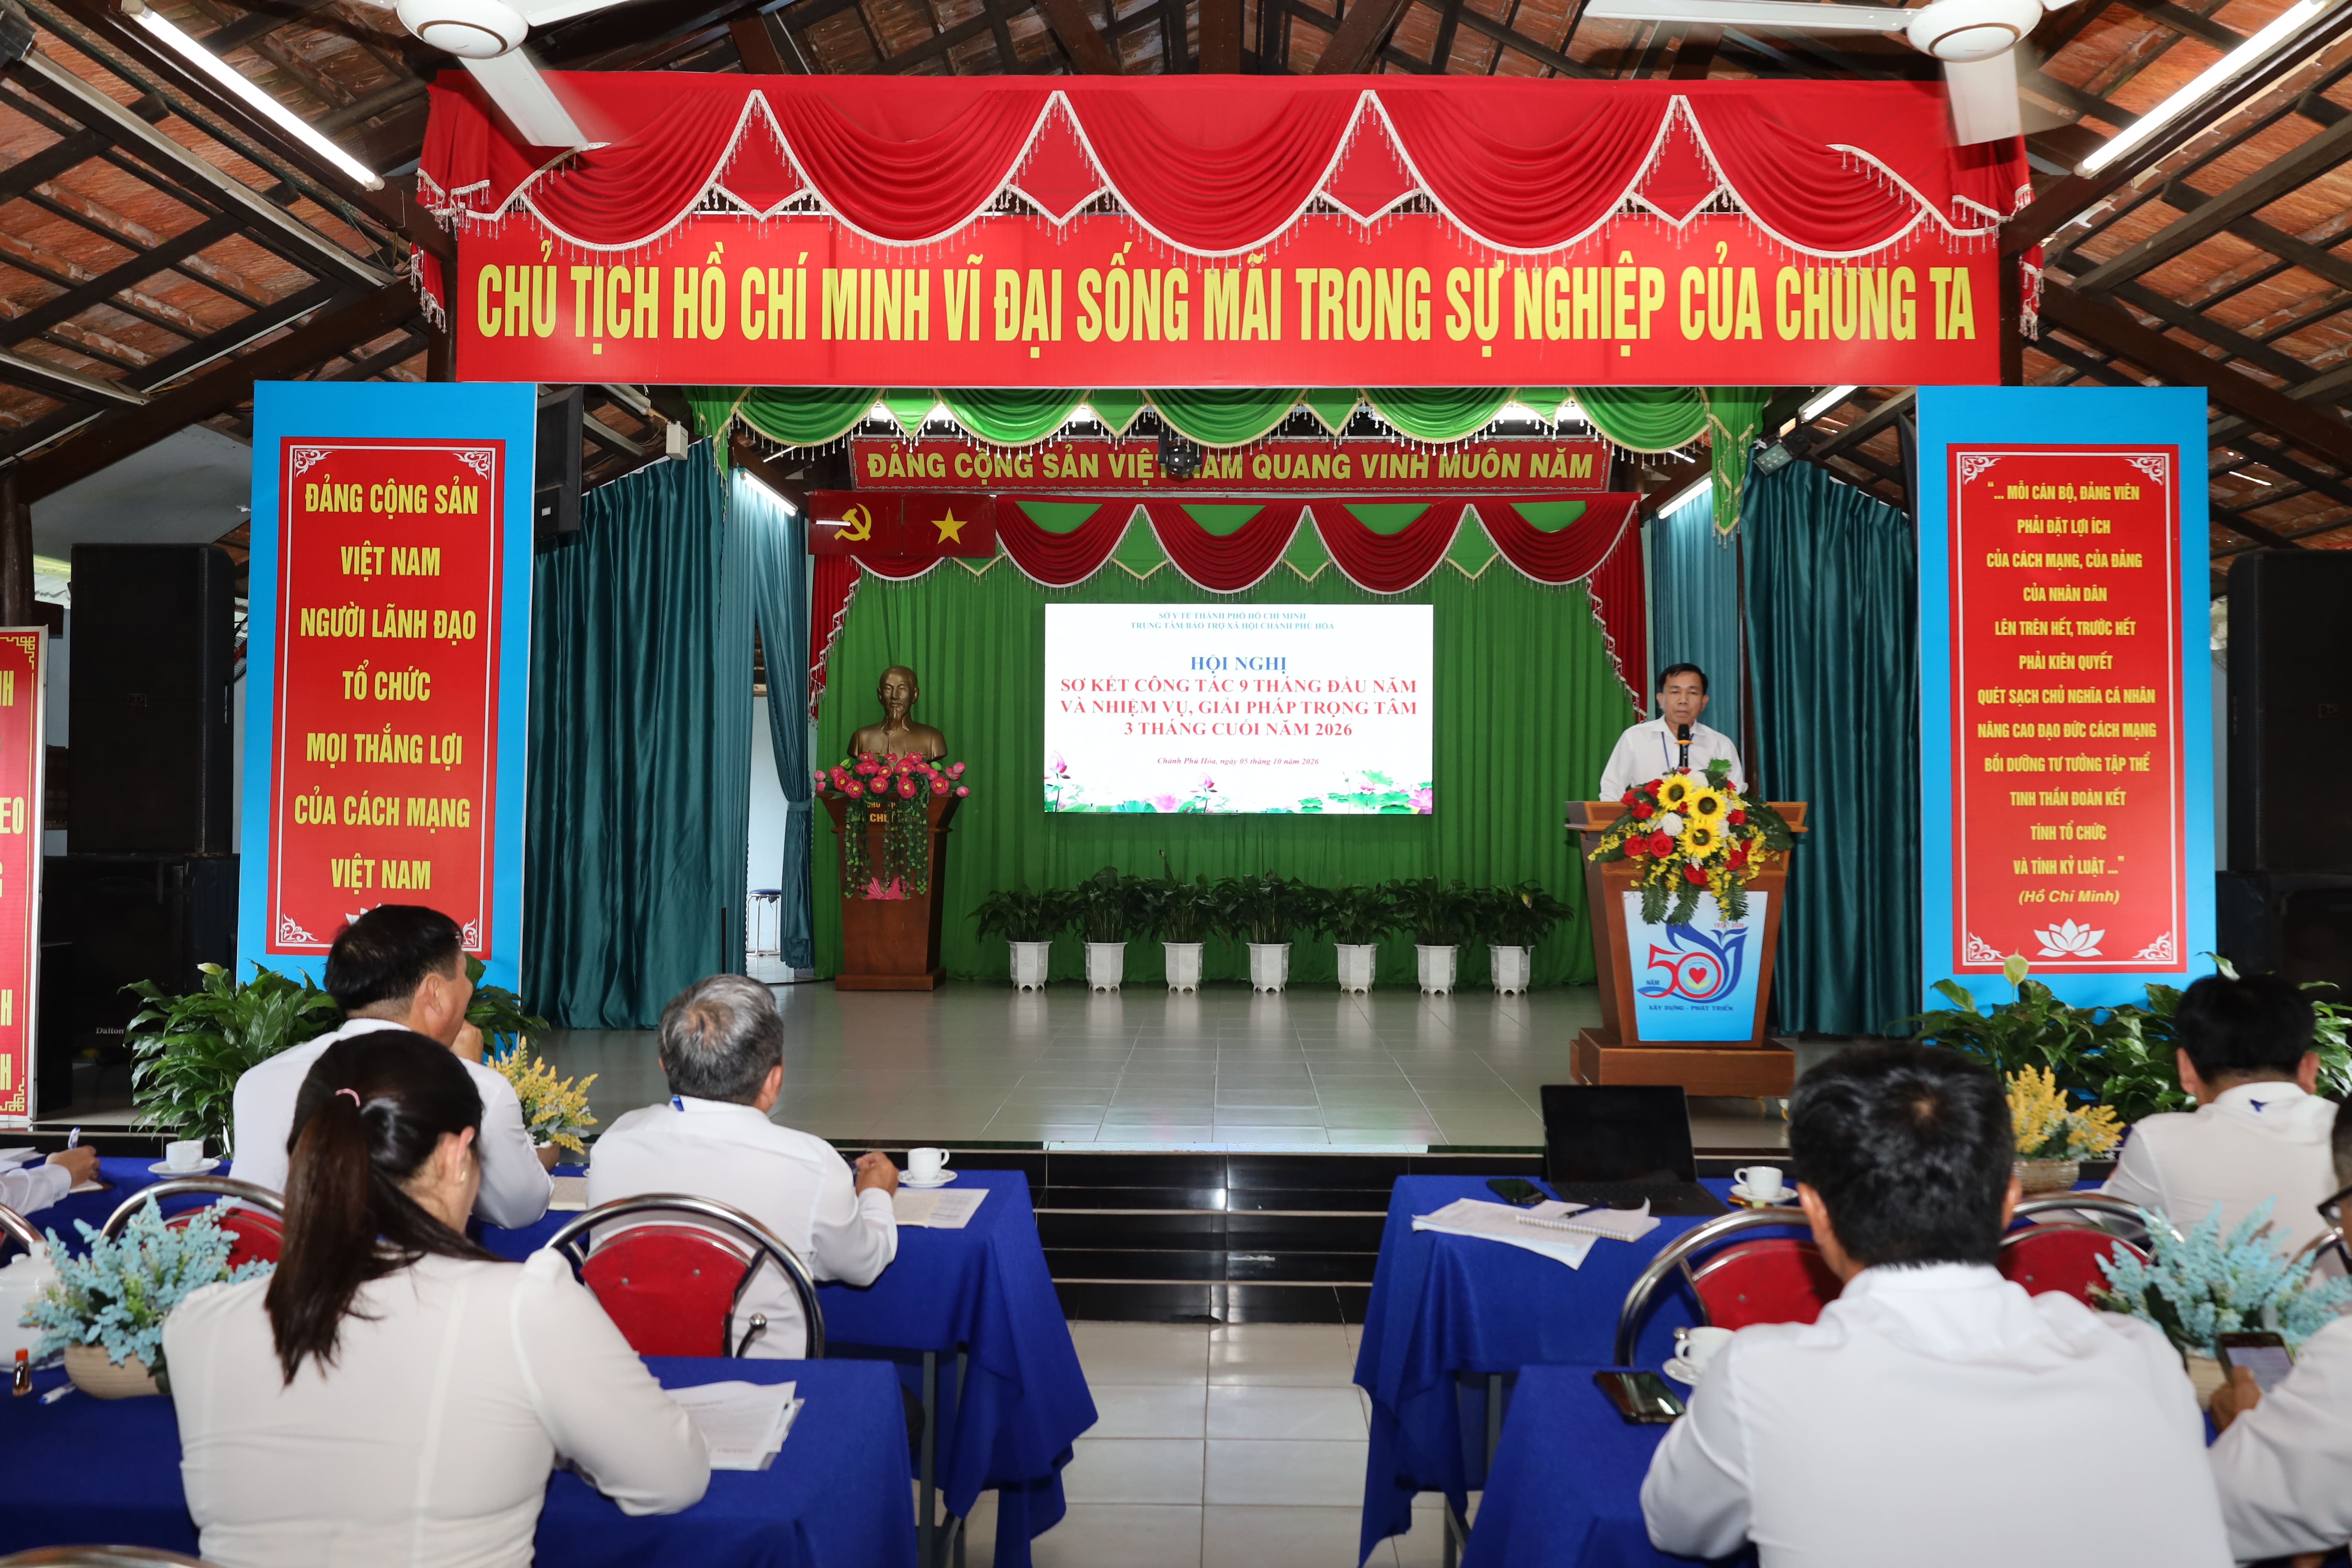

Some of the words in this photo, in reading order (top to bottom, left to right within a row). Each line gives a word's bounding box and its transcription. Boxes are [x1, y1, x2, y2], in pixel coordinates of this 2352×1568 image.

[478, 240, 557, 337] CHỦ
[571, 265, 659, 354] TỊCH
[673, 242, 726, 340] HỒ
[741, 252, 807, 340] CHÍ
[822, 268, 929, 340] MINH
[944, 254, 983, 340] VĨ
[994, 269, 1062, 358] ĐẠI
[1077, 242, 1188, 341] SỐNG
[1204, 254, 1281, 340] MÃI
[1296, 267, 1431, 341] TRONG
[1446, 260, 1504, 357] SỰ
[1514, 251, 1665, 357] NGHIỆP
[1680, 241, 1762, 340] CỦA
[1776, 258, 1916, 341] CHÚNG
[1929, 267, 1976, 340] TA
[867, 443, 946, 478] ĐẢNG
[954, 448, 1034, 485] CỘNG
[1043, 444, 1099, 478] SẢN
[1253, 454, 1351, 480] QUANG
[1361, 454, 1430, 479] VINH
[1438, 447, 1521, 479] MUÔN
[1530, 447, 1593, 478] NĂM
[305, 473, 363, 513] ĐẢNG
[370, 478, 427, 519] CỘNG
[434, 475, 478, 514] SẢN
[2007, 480, 2030, 500] MỖI
[2031, 483, 2056, 500] CÁN
[2058, 482, 2078, 503] BỘ,
[2079, 481, 2112, 500] ĐẢNG
[2113, 483, 2141, 500] VIÊN
[2017, 514, 2045, 534] PHẢI
[2046, 516, 2069, 537] ĐẶT
[2070, 518, 2090, 537] LỢI
[2091, 517, 2112, 534] ÍCH
[341, 540, 385, 582] VIỆT
[391, 547, 441, 576] NAM
[1986, 548, 2011, 568] CỦA
[2012, 550, 2044, 568] CÁCH
[2045, 553, 2084, 571] MẠNG,
[2085, 548, 2110, 568] CỦA
[2110, 548, 2143, 568] ĐẢNG
[2023, 582, 2047, 602] CỦA
[2048, 584, 2082, 602] NHÂN
[2083, 584, 2108, 602] DÂN
[300, 601, 365, 637] NGƯỜI
[372, 603, 427, 639] LÃNH
[433, 610, 476, 646] ĐẠO
[1159, 611, 1171, 619] SỞ
[1180, 611, 1191, 619] TẾ
[1194, 611, 1225, 619] THÀNH
[1227, 611, 1246, 620] PHỐ
[1248, 611, 1262, 619] HỒ
[1263, 611, 1280, 619] CHÍ
[1164, 620, 1184, 629] TÂM
[1186, 621, 1204, 629] BẢO
[1206, 622, 1225, 631] TRỢ
[1227, 621, 1239, 629] XÃ
[1242, 622, 1258, 631] HỘI
[1260, 621, 1292, 629] CHÁNH
[1295, 621, 1312, 629] PHÚ
[1315, 621, 1334, 629] HÒA
[1994, 618, 2017, 636] LÊN
[2018, 618, 2049, 636] TRÊN
[2050, 617, 2074, 637] HẾT,
[2075, 618, 2113, 636] TRƯỚC
[2115, 617, 2137, 636] HẾT
[1191, 654, 1227, 674] HỘI
[1235, 657, 1286, 674] NGHỊ
[2018, 651, 2047, 670] PHẢI
[2048, 652, 2076, 670] KIÊN
[2078, 651, 2114, 671] QUYẾT
[342, 659, 369, 700] TỔ
[374, 666, 430, 701] CHỨC
[1061, 678, 1086, 691] SƠ
[1092, 675, 1129, 692] KẾT
[1135, 675, 1189, 692] CÔNG
[1195, 675, 1234, 692] TÁC
[1239, 680, 1248, 692] 9
[1253, 676, 1321, 692] THÁNG
[1327, 676, 1366, 693] ĐẦU
[1374, 677, 1416, 693] NĂM
[1977, 686, 2007, 706] QUÉT
[2008, 689, 2040, 707] SẠCH
[2041, 684, 2066, 704] CHỦ
[2067, 686, 2104, 704] NGHĨA
[2105, 686, 2122, 704] CÁ
[2123, 686, 2156, 703] NHÂN
[1061, 696, 1086, 713] VÀ
[1093, 698, 1156, 717] NHIỆM
[1162, 701, 1193, 717] VỤ,
[1199, 697, 1239, 714] GIẢI
[1247, 697, 1296, 714] PHÁP
[1300, 701, 1368, 718] TRỌNG
[1374, 698, 1416, 714] TÂM
[1124, 722, 1133, 735] 3
[1138, 718, 1205, 735] THÁNG
[1212, 719, 1259, 735] CUỐI
[1266, 720, 1309, 735] NĂM
[1315, 723, 1352, 736] 2026
[1977, 720, 2011, 738] NÂNG
[2012, 723, 2036, 738] CAO
[2037, 723, 2062, 741] ĐẠO
[2063, 720, 2087, 738] ĐỨC
[2089, 720, 2121, 738] CÁCH
[2122, 723, 2158, 741] MẠNG
[306, 733, 347, 769] MỌI
[354, 723, 423, 764] THẮNG
[430, 733, 462, 771] LỢI
[1984, 753, 2005, 772] BỒI
[2006, 754, 2046, 772] DƯỠNG
[2047, 756, 2065, 772] TƯ
[2064, 752, 2103, 772] TƯỞNG
[2104, 754, 2127, 775] TẬP
[2128, 752, 2151, 772] THỂ
[2009, 791, 2037, 806] TINH
[2038, 787, 2070, 806] THẦN
[2071, 790, 2104, 806] ĐOÀN
[2105, 787, 2127, 806] KẾT
[295, 786, 336, 824] CỦA
[343, 790, 400, 826] CÁCH
[406, 798, 470, 833] MẠNG
[2030, 823, 2057, 840] TÍNH
[2059, 820, 2075, 841] TỔ
[2076, 823, 2107, 840] CHỨC
[331, 853, 375, 894] VIỆT
[381, 860, 430, 890] NAM
[2013, 857, 2029, 875] VÀ
[2030, 857, 2058, 874] TÍNH
[2060, 855, 2075, 874] KỶ
[2077, 856, 2105, 877] LUẬT
[2018, 889, 2046, 905] (Hồ
[2049, 890, 2075, 903] Chí
[2078, 890, 2121, 905] Minh)
[1712, 1003, 1733, 1011] TRIỂN
